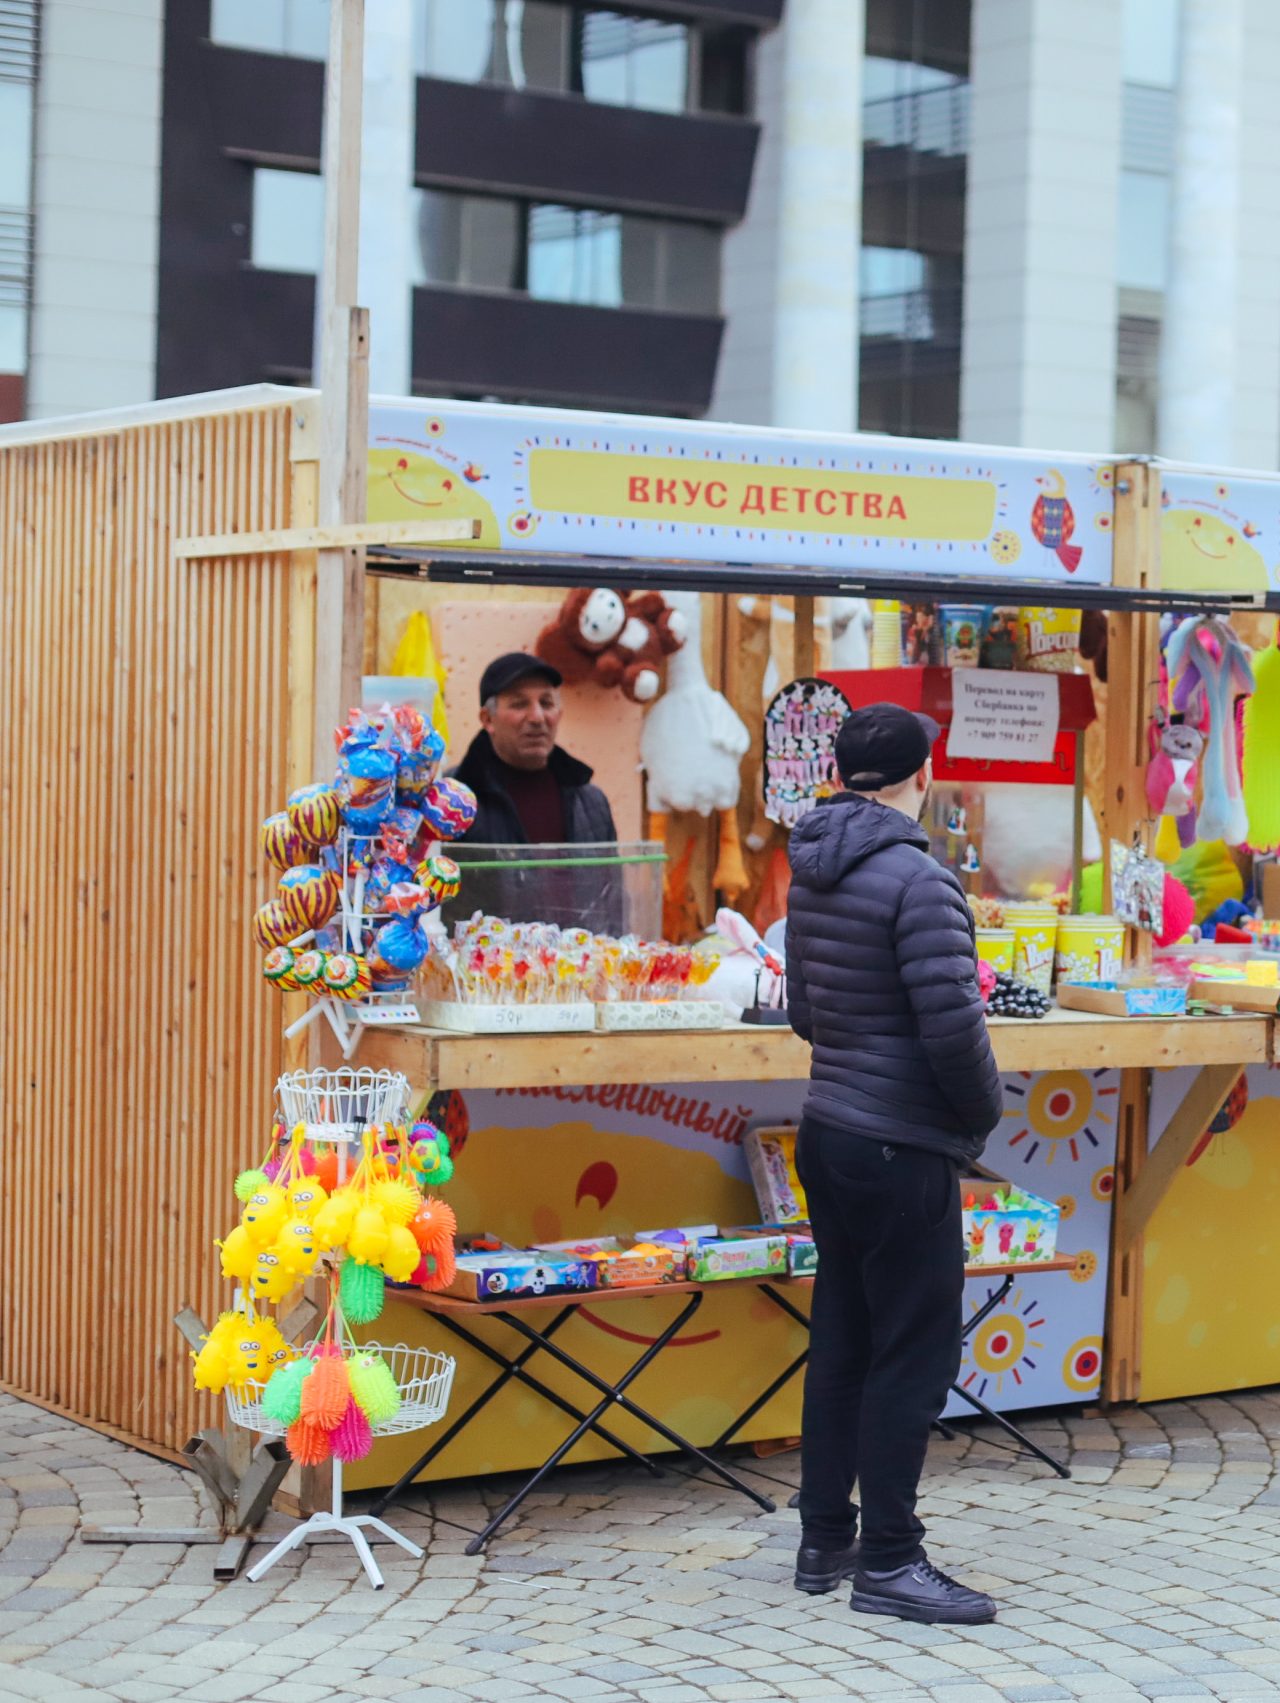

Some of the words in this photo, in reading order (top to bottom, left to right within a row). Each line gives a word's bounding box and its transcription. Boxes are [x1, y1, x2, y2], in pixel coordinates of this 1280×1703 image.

[628, 476, 728, 508] ВКУС
[740, 484, 907, 520] ДЕТСТВА
[964, 683, 1003, 696] Перевод
[1019, 690, 1046, 699] карту
[974, 699, 1024, 712] Сбербанка
